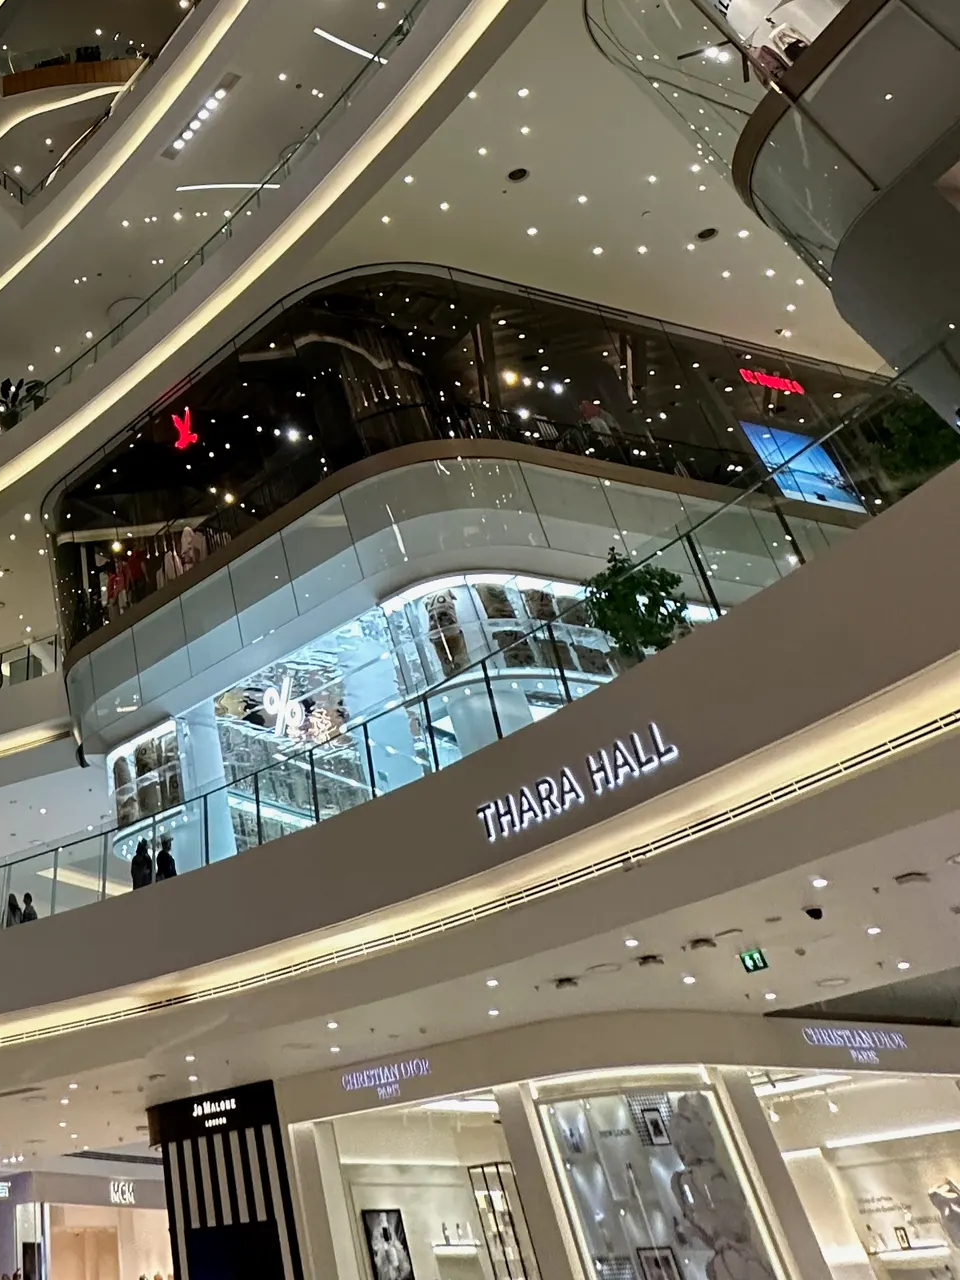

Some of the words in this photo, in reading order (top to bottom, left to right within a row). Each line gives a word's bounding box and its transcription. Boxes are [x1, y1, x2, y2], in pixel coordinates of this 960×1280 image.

[476, 766, 585, 843] THARA
[585, 721, 679, 796] HALL
[802, 1026, 876, 1048] CHRISTIAN
[872, 1031, 908, 1050] DIOR
[848, 1049, 880, 1065] PARIS
[342, 1063, 400, 1092] CHRISTIAN
[400, 1057, 431, 1079] DIOR
[376, 1083, 401, 1100] PARIS
